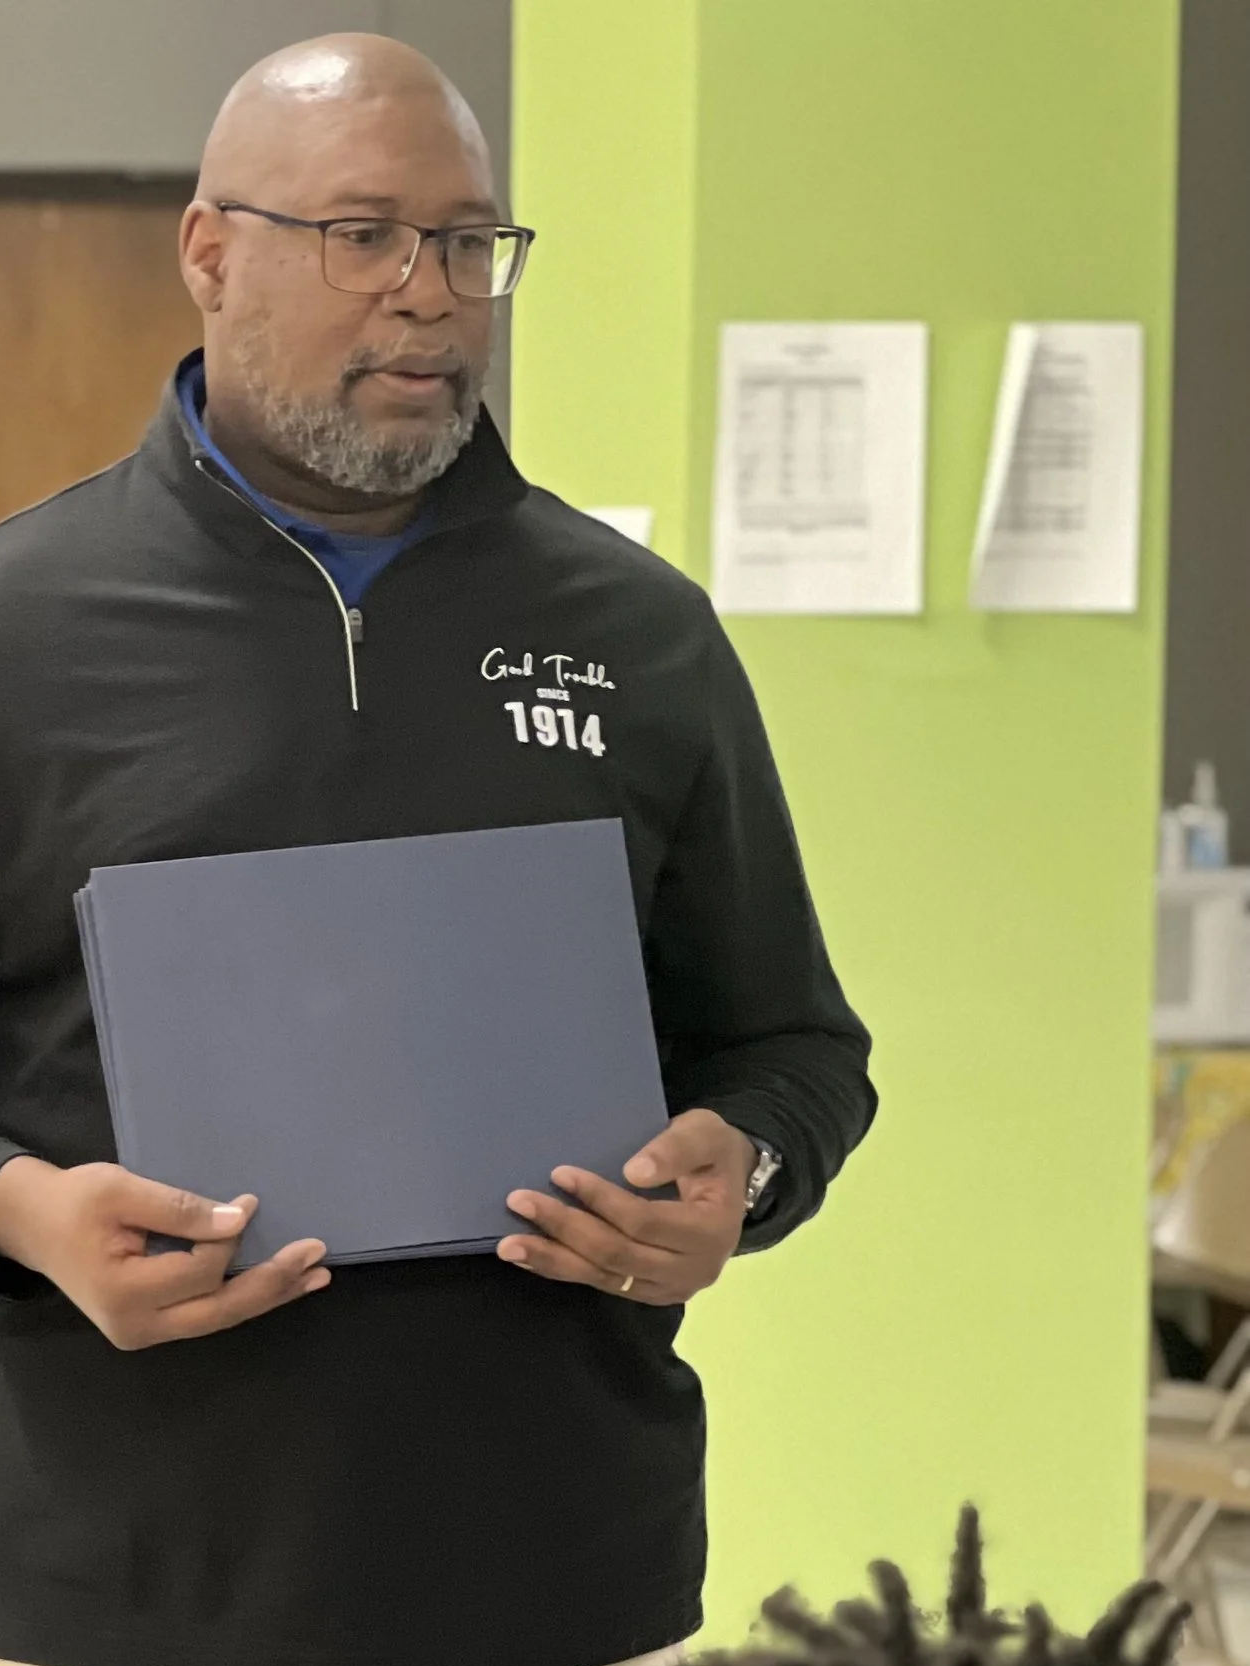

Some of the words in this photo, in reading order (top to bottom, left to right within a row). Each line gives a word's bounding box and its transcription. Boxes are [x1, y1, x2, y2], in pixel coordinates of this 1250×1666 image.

[481, 647, 535, 681] Good
[542, 654, 616, 690] Trouble
[535, 687, 571, 702] SINCE
[503, 701, 607, 757] 1914
